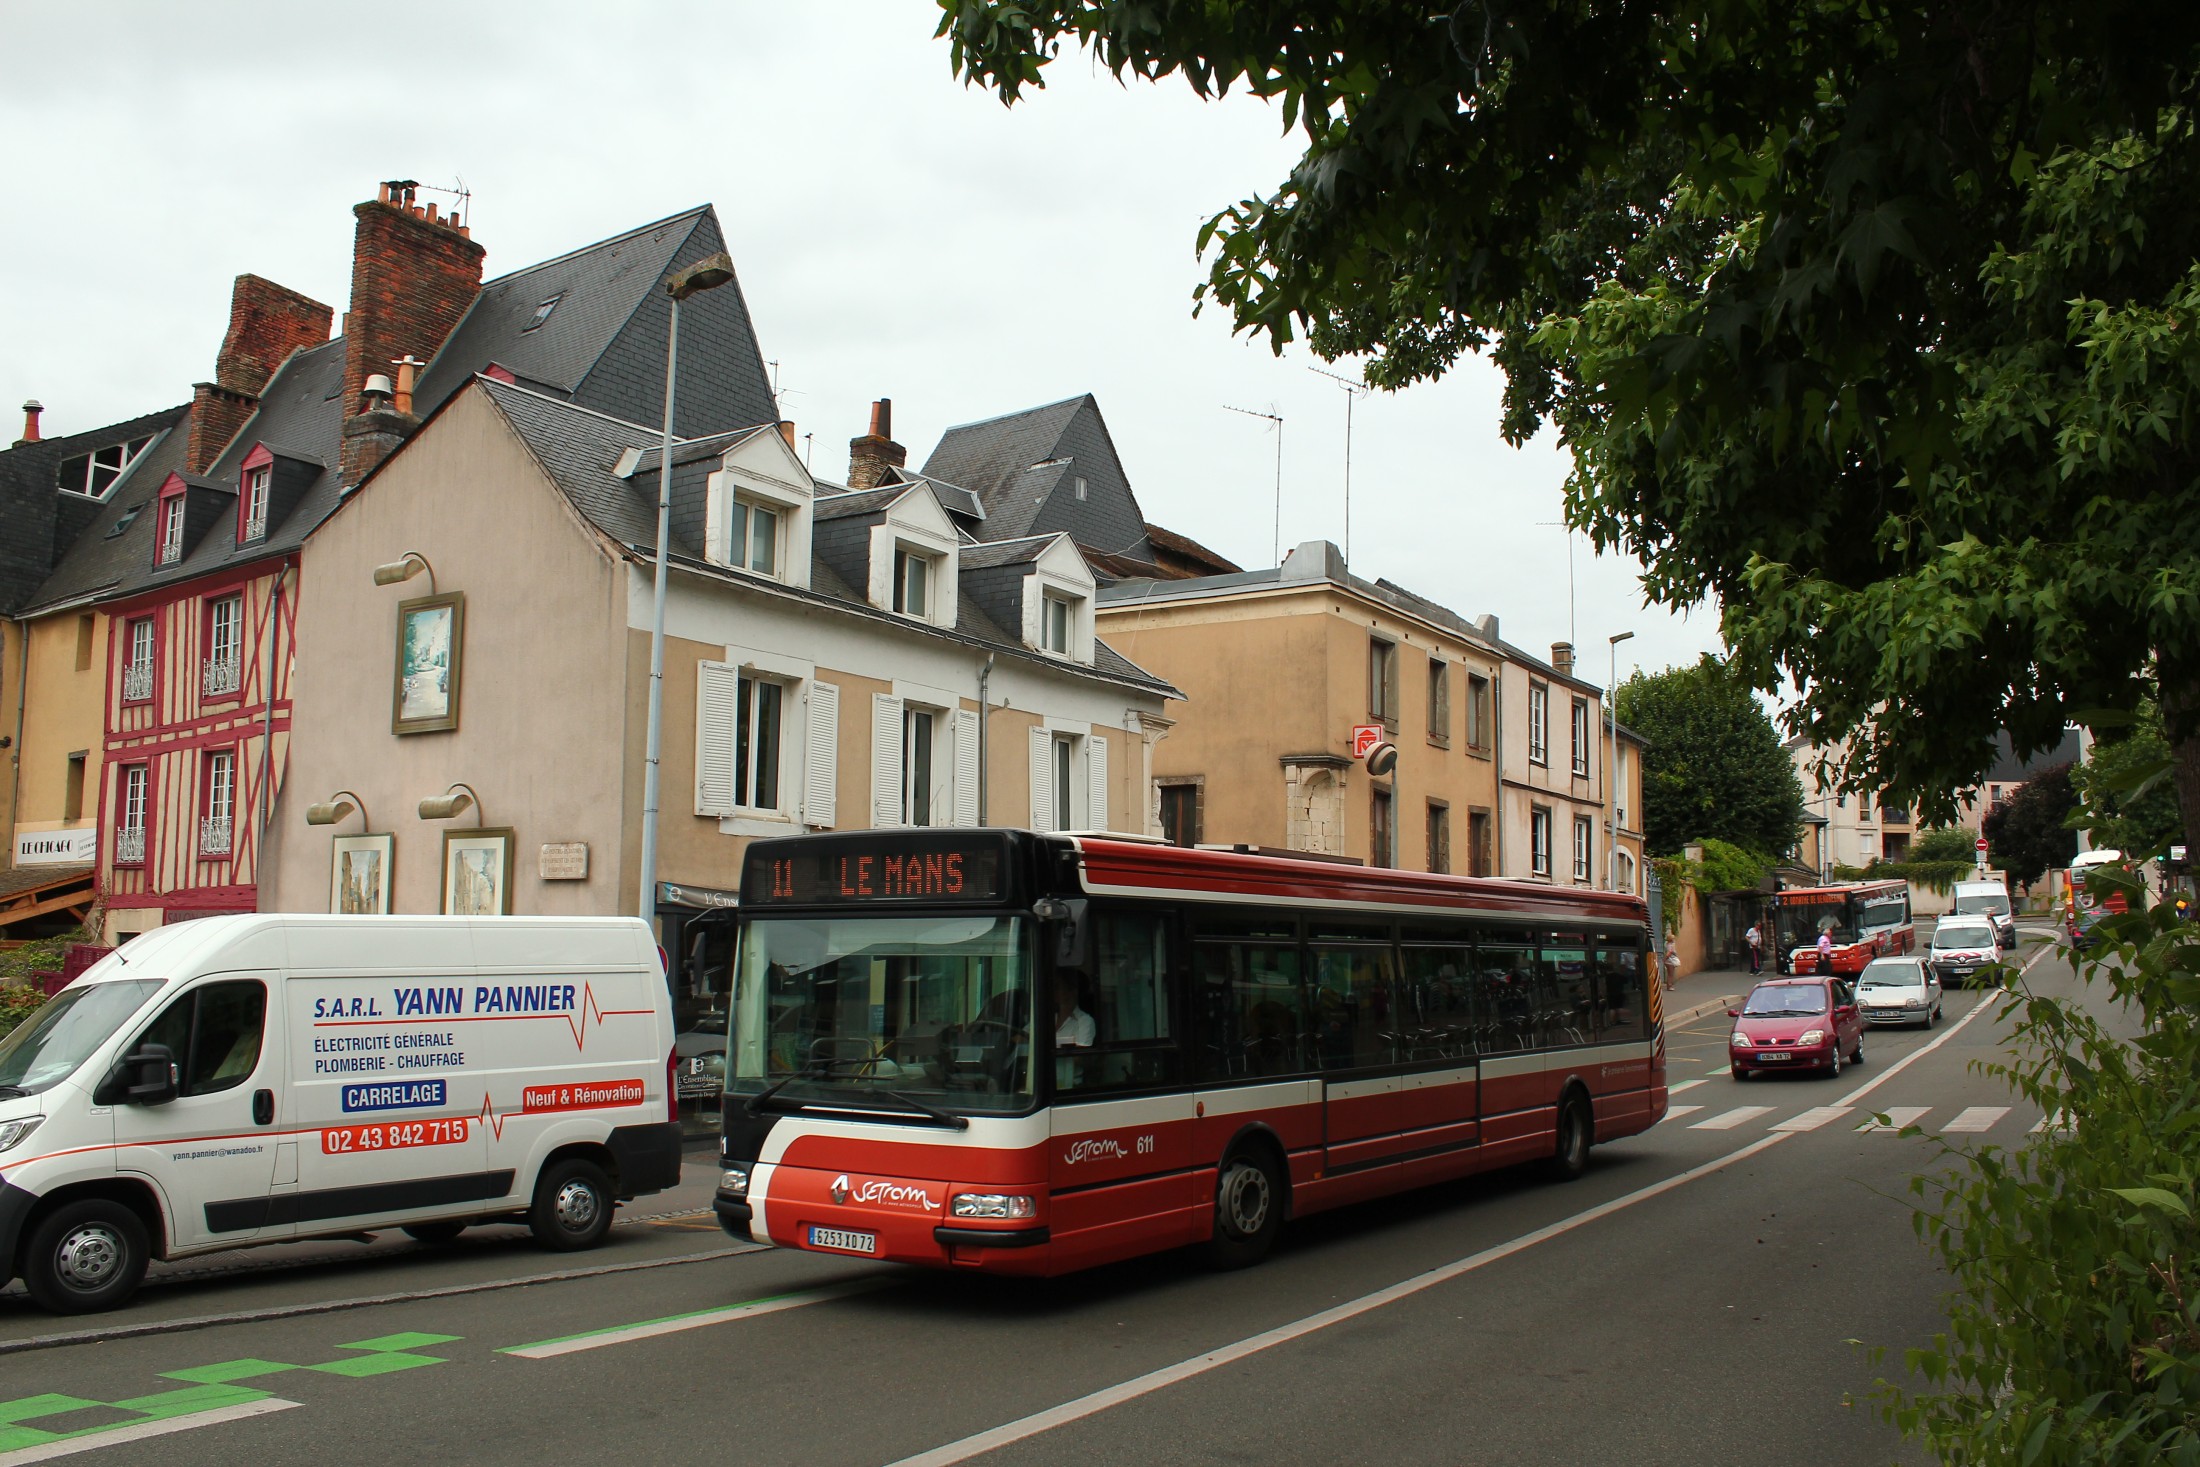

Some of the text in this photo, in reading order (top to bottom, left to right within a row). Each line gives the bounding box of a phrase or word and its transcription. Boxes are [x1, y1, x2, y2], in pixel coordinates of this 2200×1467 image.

[34, 839, 73, 854] CHICAGO
[772, 853, 963, 896] 11 LE MANS
[314, 984, 576, 1018] S.A.R.L. YANN PANNIER
[314, 1030, 454, 1053] ÉLECTRICITÉ GÉNÉRALE
[315, 1055, 386, 1074] PLOMBERIE
[397, 1052, 465, 1070] CHAUFFAGE
[347, 1083, 441, 1108] CARRELAGE
[526, 1084, 642, 1108] Neuf & Rénovation
[327, 1120, 464, 1152] 02 43 842 715
[1136, 1134, 1154, 1154] 611
[172, 1145, 264, 1161] yann.pannier@wanadoo.fr
[817, 1230, 873, 1251] 6253 XD 72
